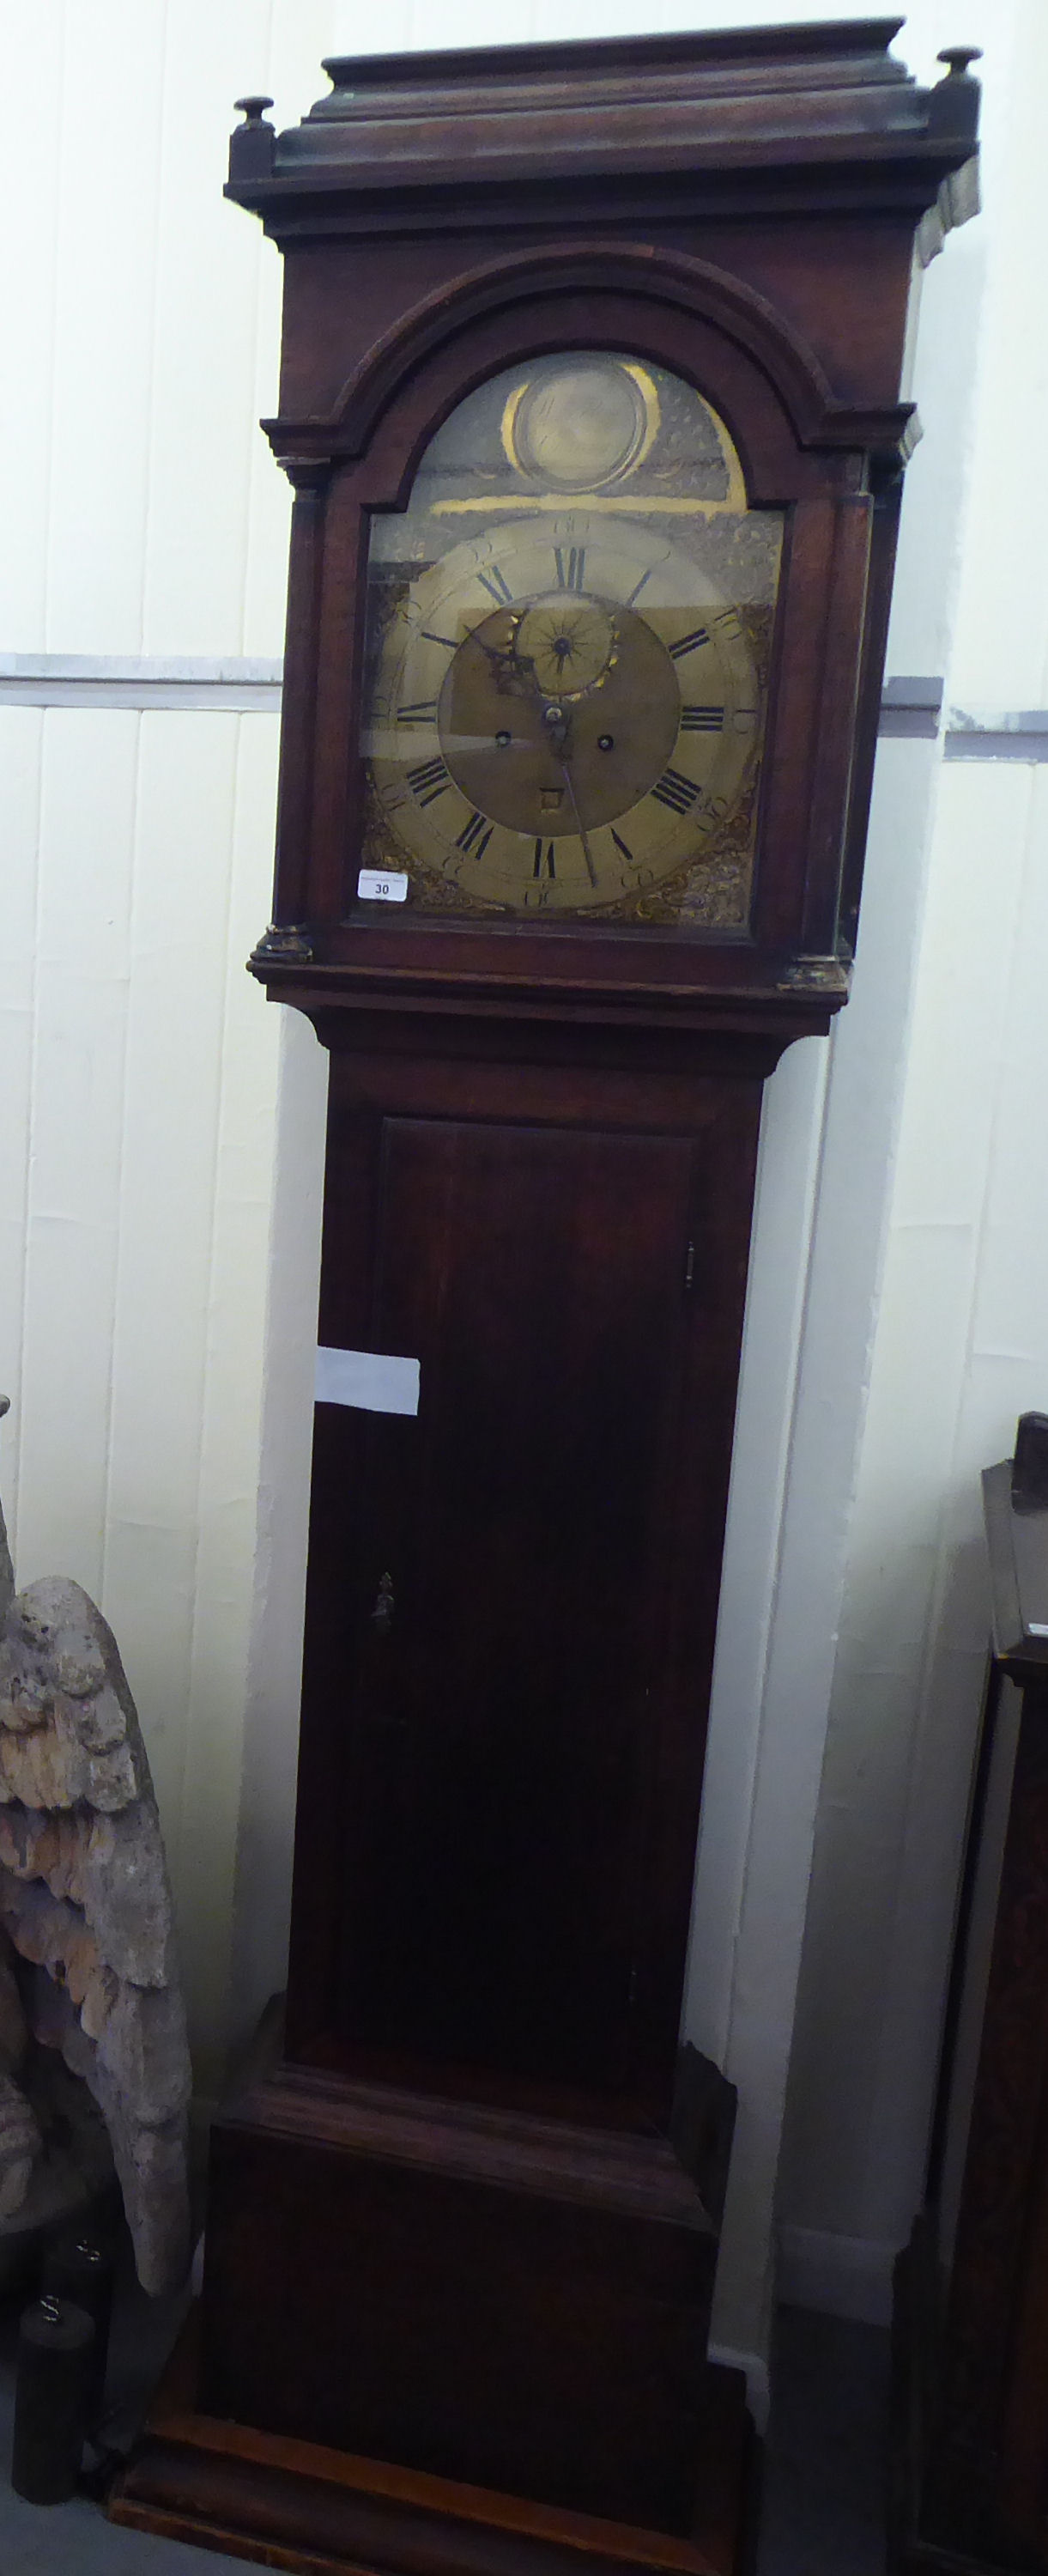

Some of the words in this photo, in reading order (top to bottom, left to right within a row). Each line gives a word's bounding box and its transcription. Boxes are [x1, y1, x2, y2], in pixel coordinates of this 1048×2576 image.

[681, 706, 724, 731] III
[650, 768, 701, 815] IIII
[375, 884, 389, 895] 30
